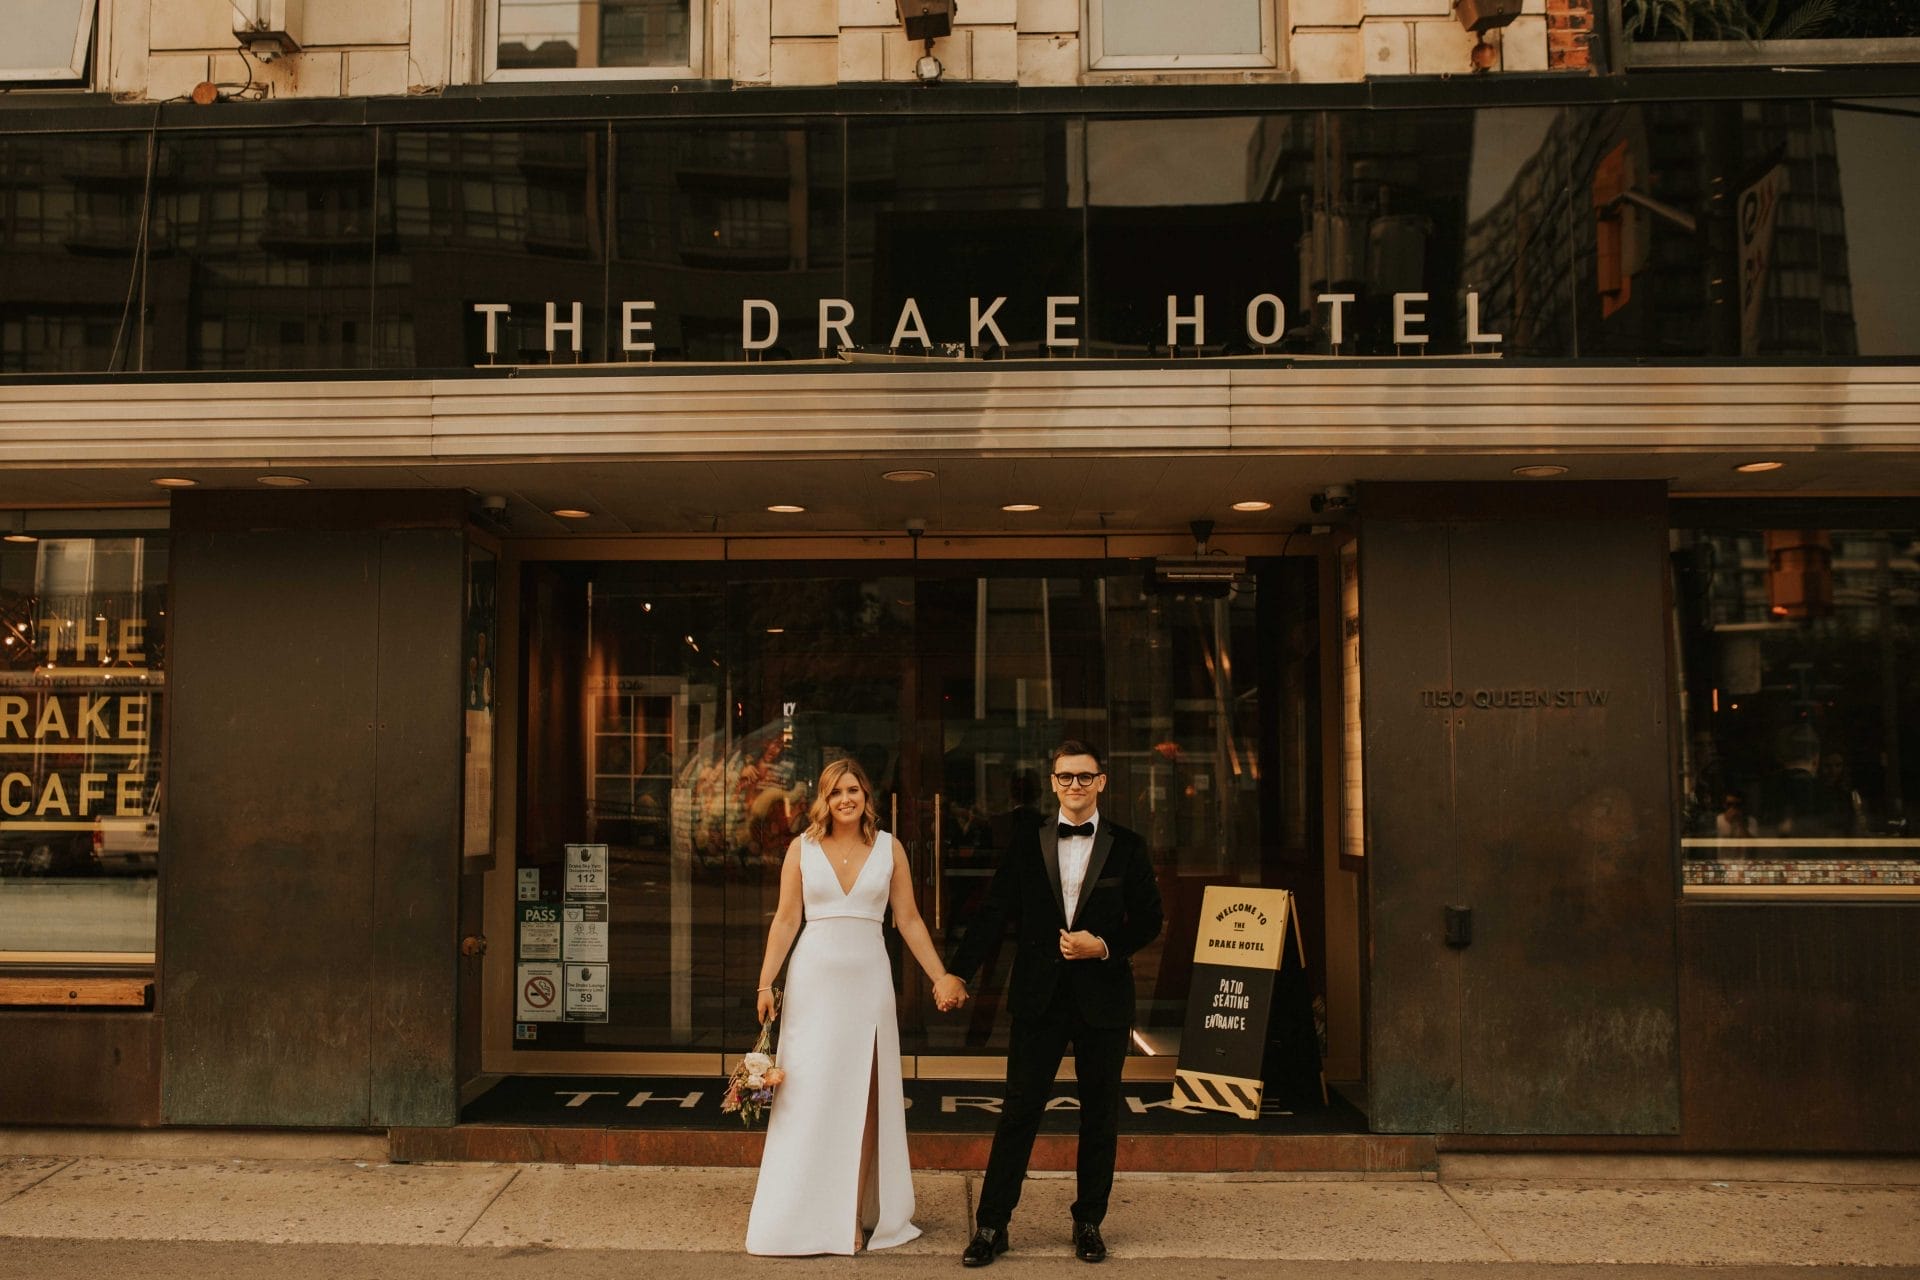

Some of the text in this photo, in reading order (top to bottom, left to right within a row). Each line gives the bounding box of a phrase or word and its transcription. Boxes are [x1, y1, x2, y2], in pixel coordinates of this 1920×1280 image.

[474, 292, 1503, 352] THE DRAKE HOTEL
[39, 619, 147, 661] THE
[1421, 689, 1609, 708] 1150 QUEEN ST W
[1, 760, 145, 816] CAFÉ
[577, 874, 595, 883] 112
[525, 909, 556, 922] PASS
[1216, 903, 1267, 926] WELCOME TO
[1234, 921, 1245, 929] THE
[1208, 939, 1265, 951] DRAKE HOTEL
[1219, 978, 1244, 995] PATIO
[580, 993, 593, 1003] 59
[1212, 994, 1250, 1009] SEATING
[1204, 1013, 1246, 1031] ENTRANCE
